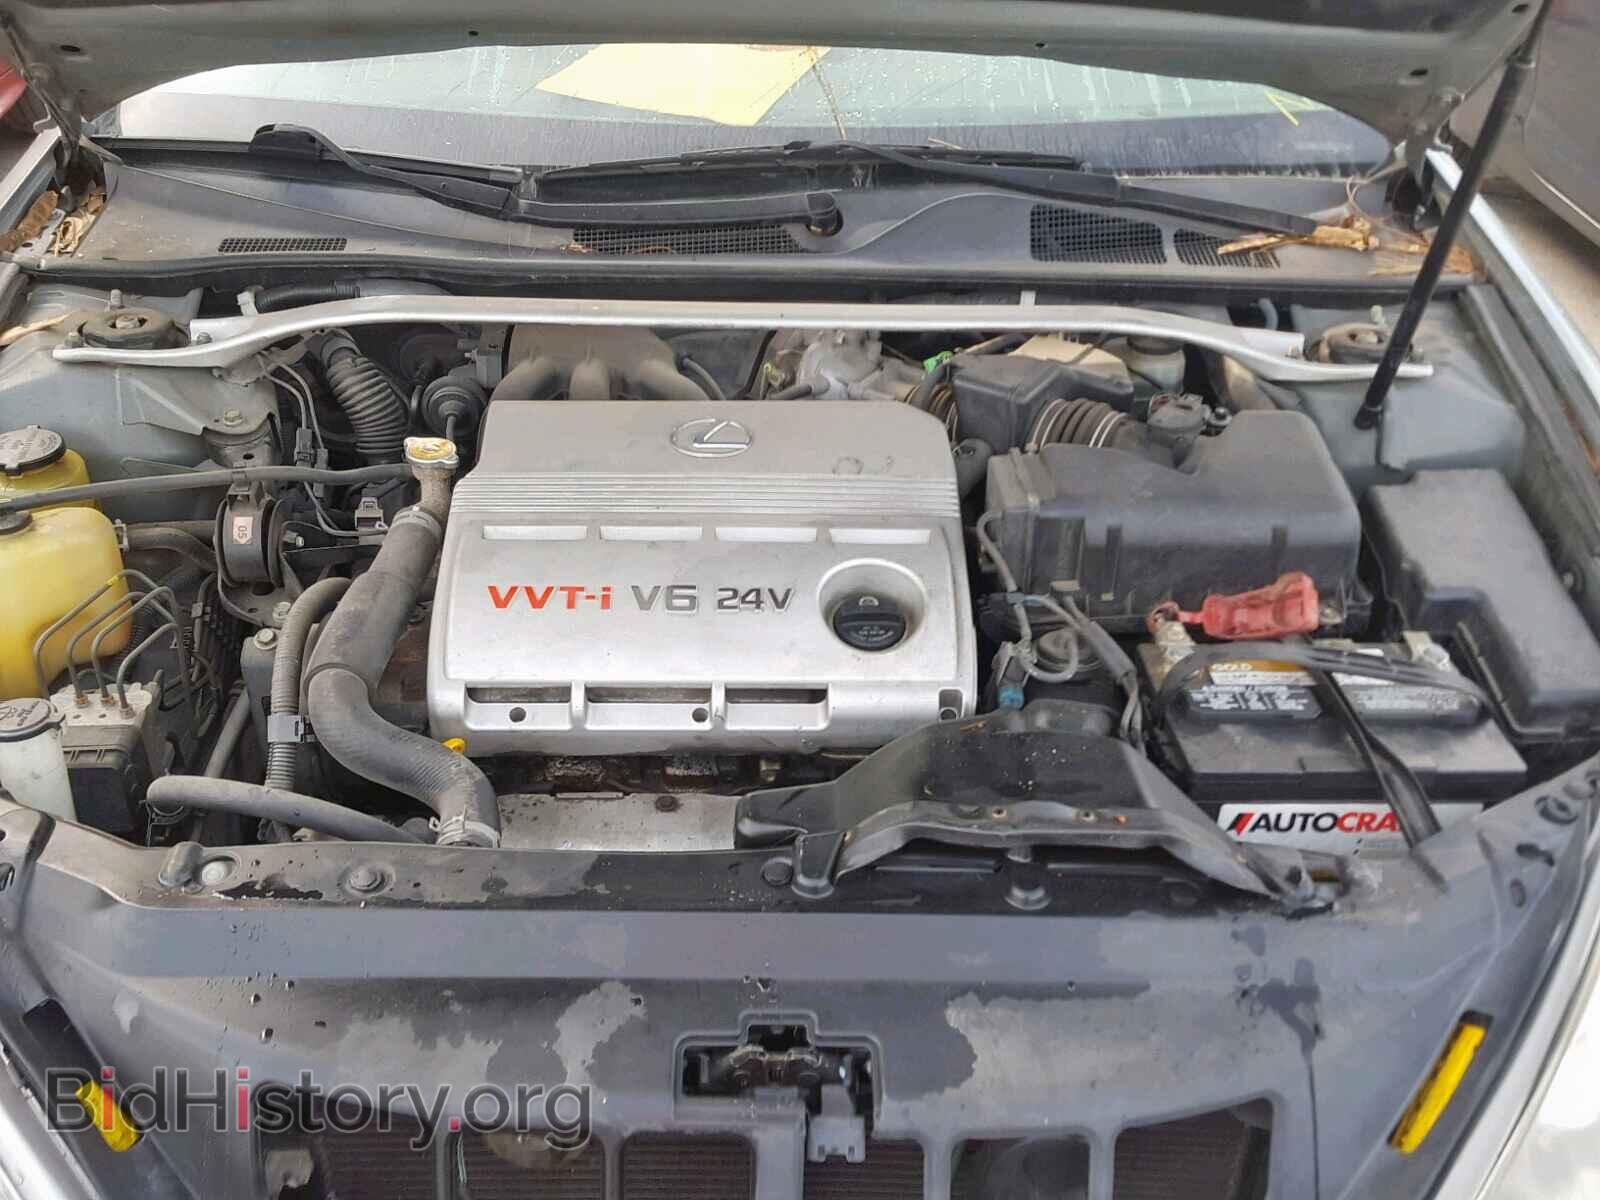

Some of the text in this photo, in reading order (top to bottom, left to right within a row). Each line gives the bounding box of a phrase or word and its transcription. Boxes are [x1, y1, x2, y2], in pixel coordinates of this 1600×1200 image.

[487, 585, 794, 612] VVT-i V6 24V
[1250, 812, 1400, 833] AUTOCRA
